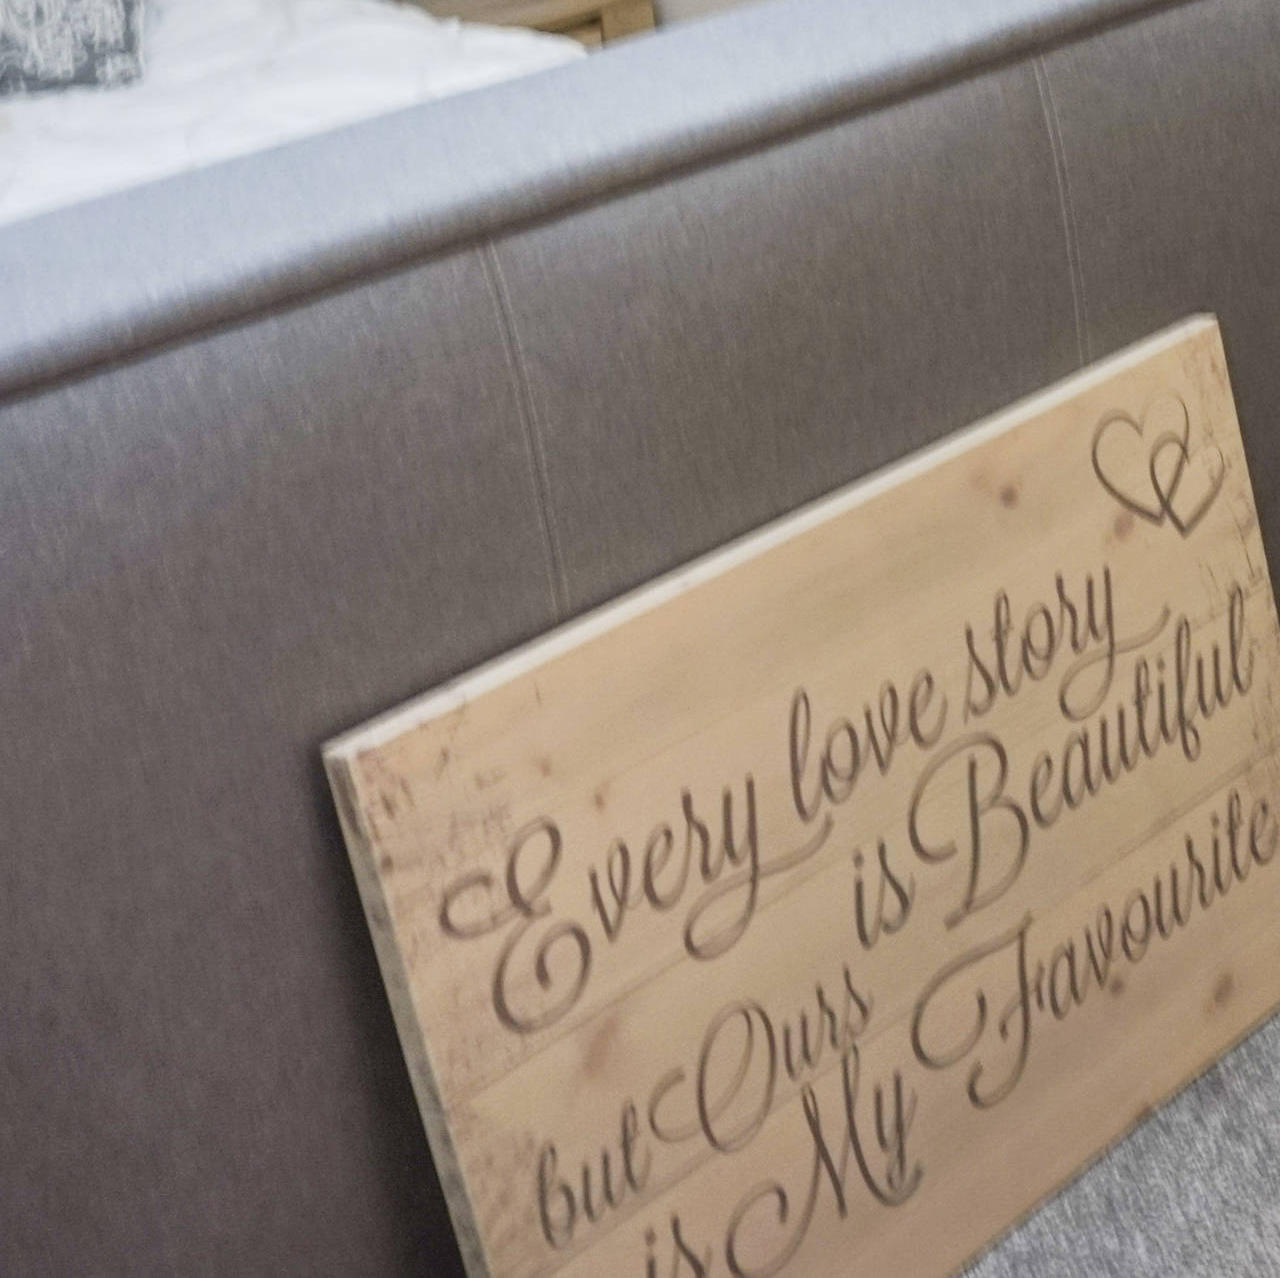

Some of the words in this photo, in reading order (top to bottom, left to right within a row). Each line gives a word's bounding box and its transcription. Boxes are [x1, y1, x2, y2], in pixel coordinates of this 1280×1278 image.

[440, 772, 834, 1036] Every
[789, 684, 948, 824] love
[964, 565, 1171, 723] story
[851, 836, 916, 950] is
[907, 580, 1254, 931] Beautiful
[537, 1097, 651, 1251] but
[648, 962, 875, 1154] Ours
[724, 1042, 924, 1278] My
[911, 788, 1280, 1109] Favourite
